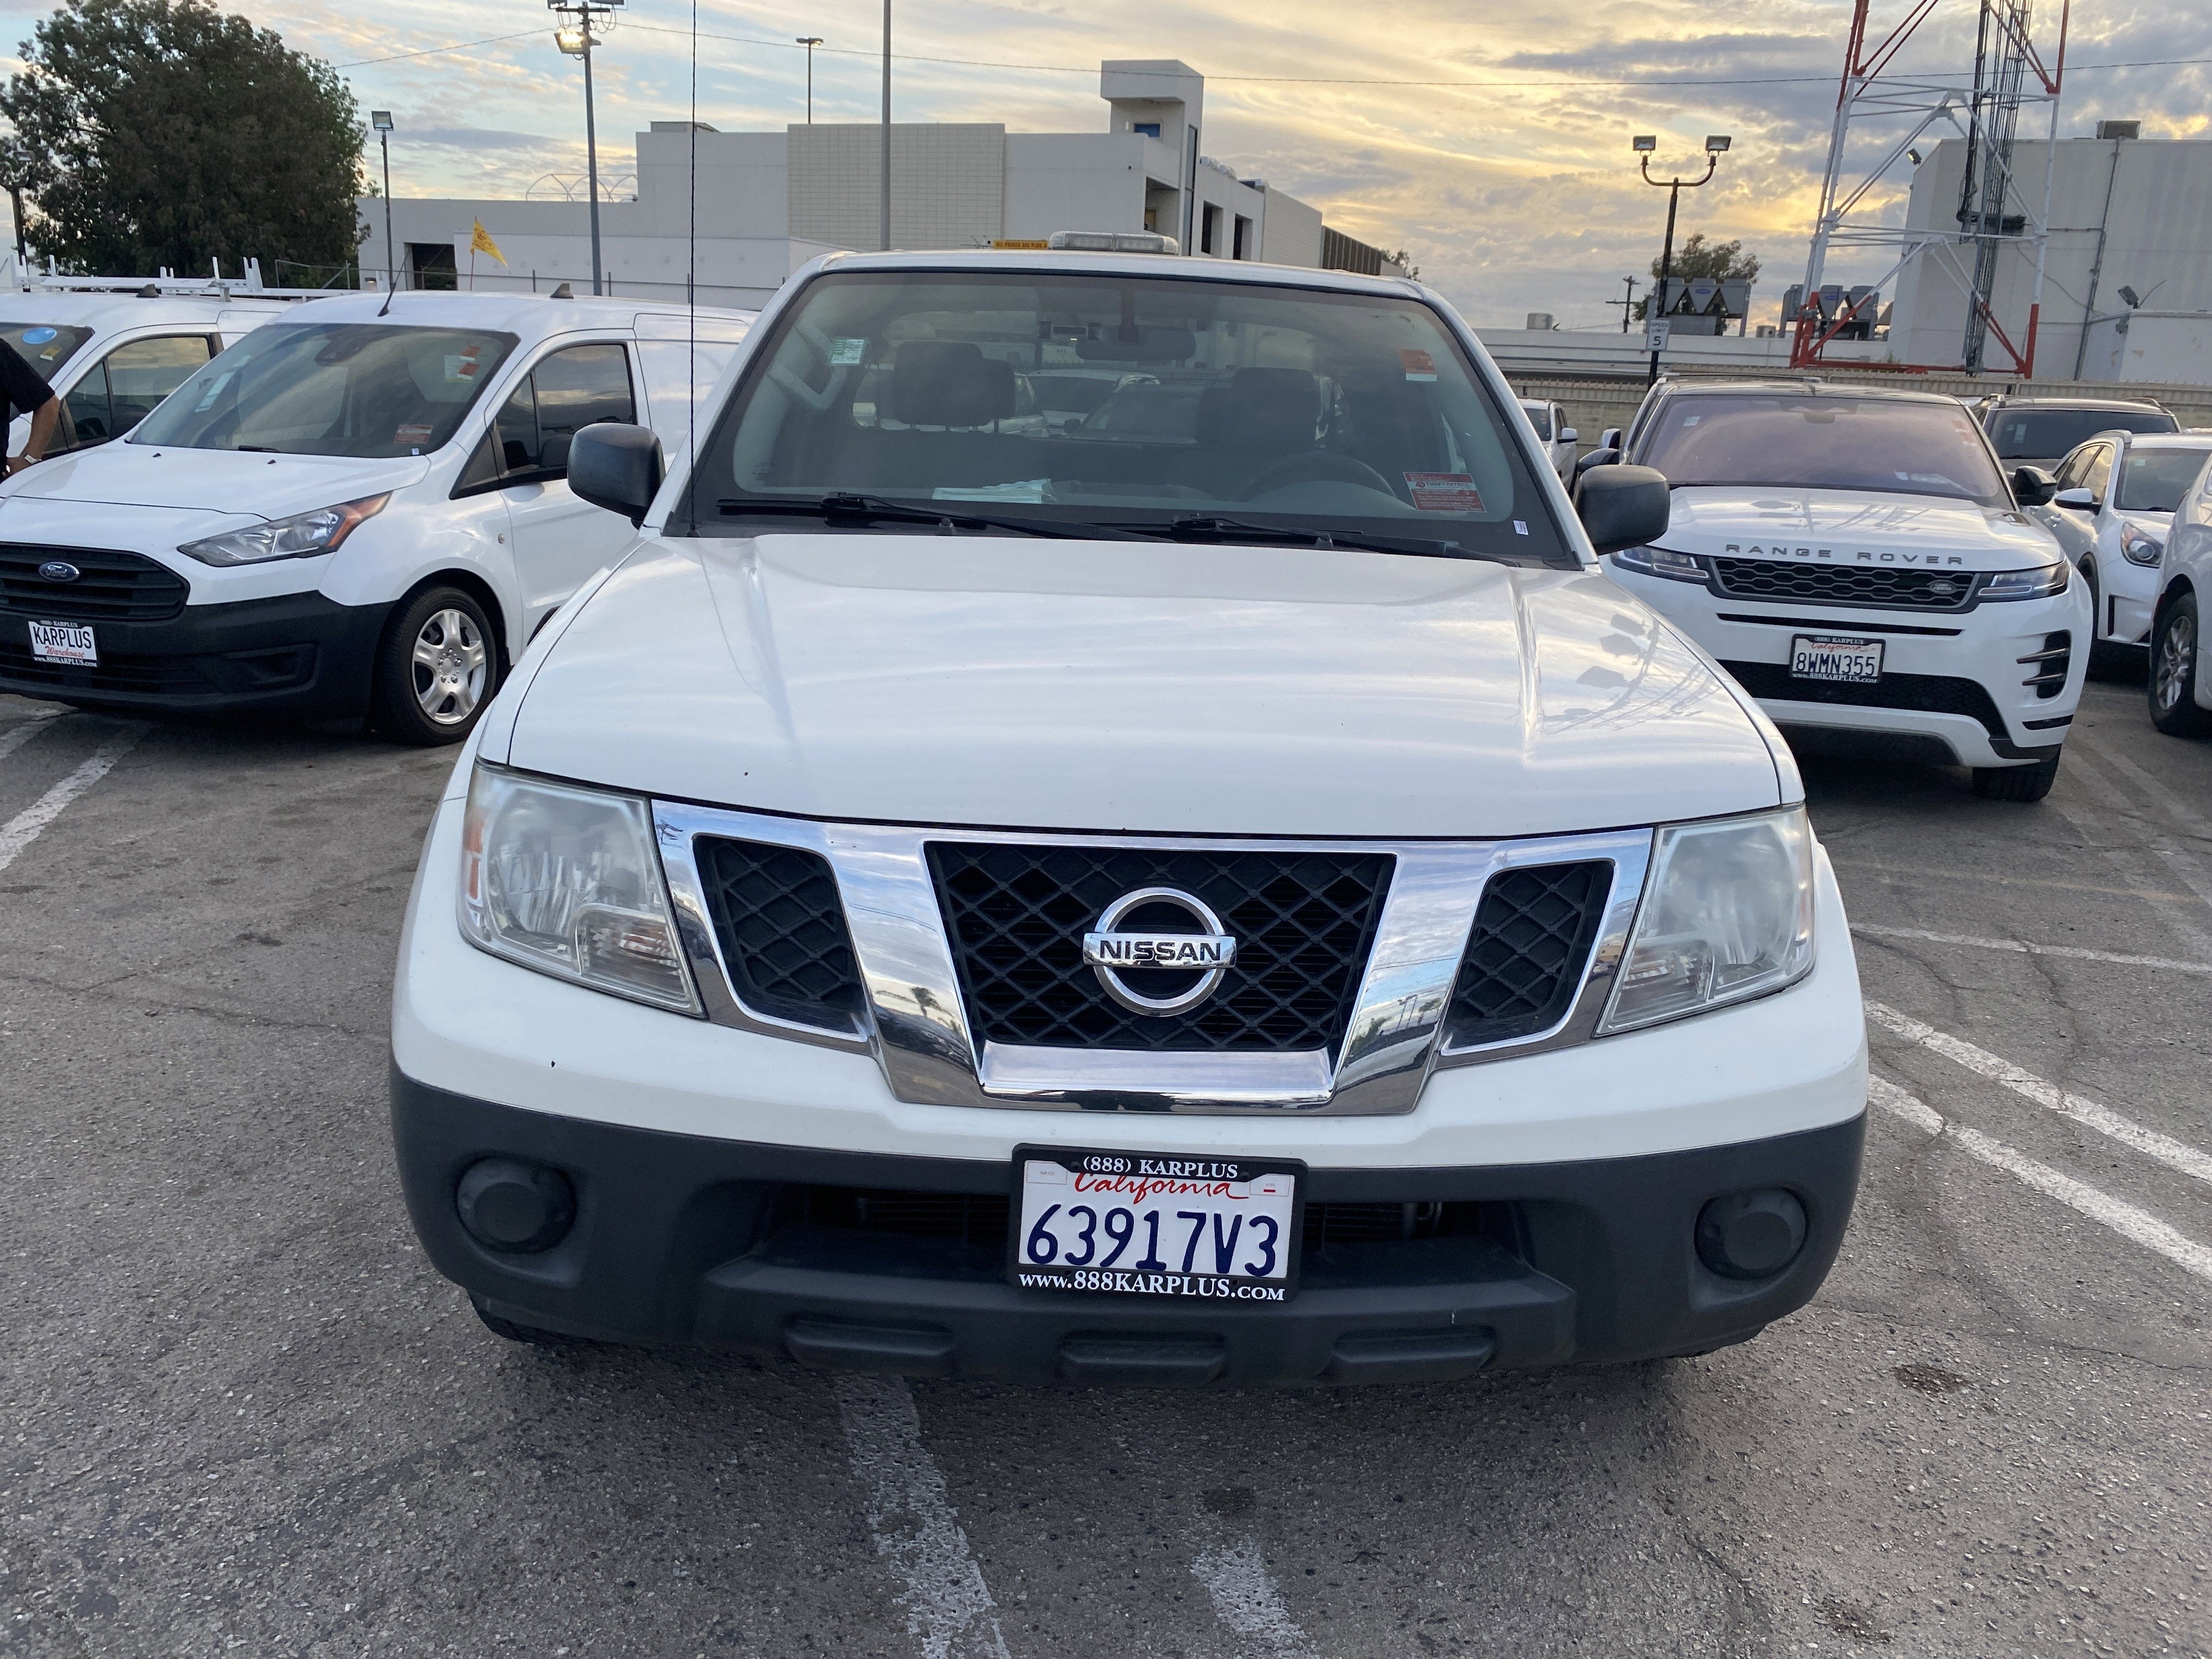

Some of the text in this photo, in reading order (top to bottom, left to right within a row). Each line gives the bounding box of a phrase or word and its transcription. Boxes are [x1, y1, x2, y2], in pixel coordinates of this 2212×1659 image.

[1653, 336, 1661, 346] 5
[1726, 544, 1962, 565] RANGE ROVER
[33, 626, 92, 649] KARPLUS
[1811, 642, 1867, 653] California
[45, 646, 85, 658] Warehouse
[1796, 652, 1875, 676] 8WMN355
[1099, 940, 1221, 962] NISSAN
[1083, 1156, 1238, 1179] (888) KARPLUS
[1074, 1172, 1250, 1205] California
[1026, 1204, 1279, 1277] 63917V3
